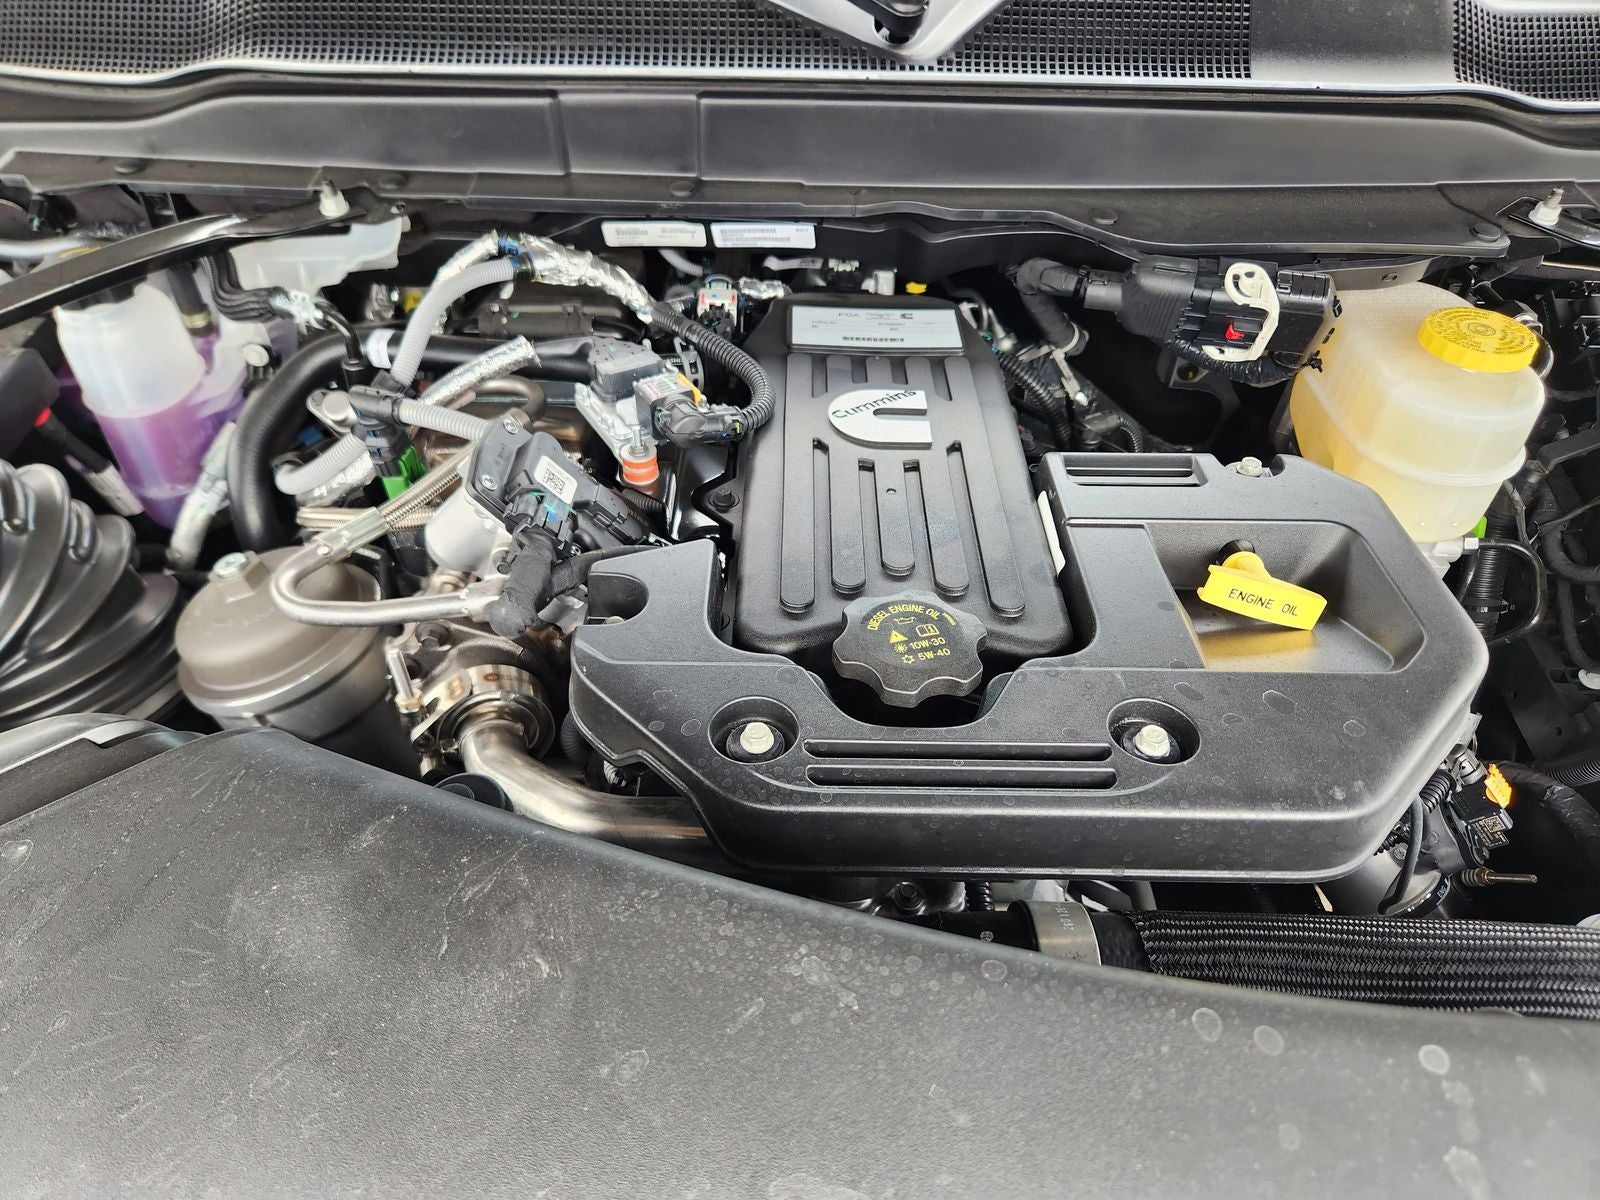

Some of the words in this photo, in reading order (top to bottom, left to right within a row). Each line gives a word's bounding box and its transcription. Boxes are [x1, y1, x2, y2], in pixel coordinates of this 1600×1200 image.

[831, 390, 917, 419] Cummins
[1228, 588, 1274, 609] ENGINE
[1281, 603, 1298, 616] OIL
[867, 610, 891, 631] DIESEL
[888, 604, 925, 614] ENGINE
[926, 608, 941, 620] OIL
[909, 637, 946, 650] 10W-30
[918, 648, 951, 661] 5W-40
